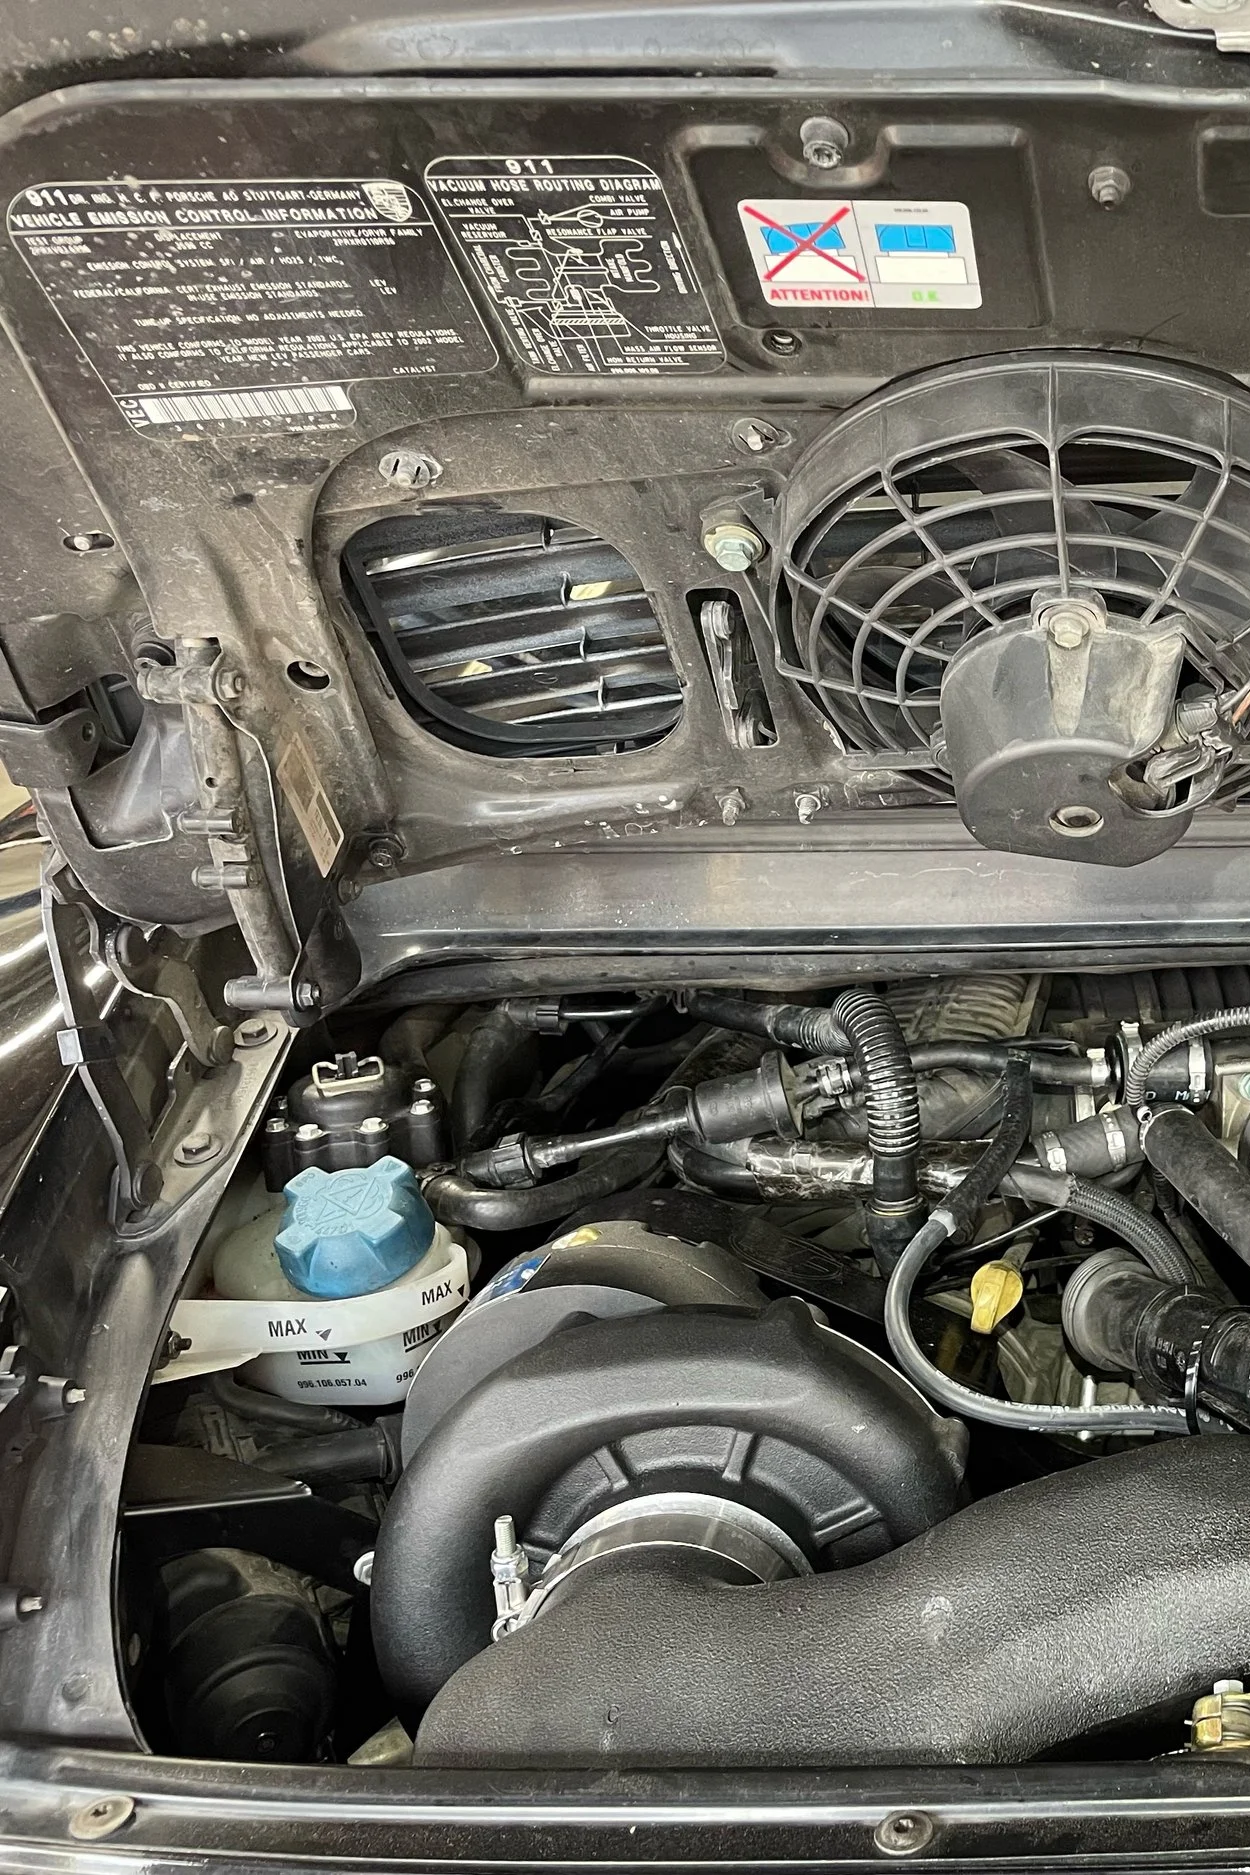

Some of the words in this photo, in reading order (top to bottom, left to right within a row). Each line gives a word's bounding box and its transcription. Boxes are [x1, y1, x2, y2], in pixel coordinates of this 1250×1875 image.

[505, 159, 554, 174] 911
[427, 179, 486, 192] VACUUM
[489, 179, 530, 192] HOSE
[533, 179, 596, 192] ROUTING
[598, 178, 662, 190] DIAGRAM
[25, 189, 69, 207] 911
[166, 190, 217, 203] PORSCHE
[222, 188, 240, 202] AG
[490, 198, 515, 206] OVER
[588, 194, 616, 203] COMBI
[618, 194, 647, 203] VALVE
[468, 206, 497, 215] VALVE
[609, 208, 624, 216] AIR
[626, 208, 650, 216] PUMP
[10, 212, 84, 228] VEHICLE
[87, 210, 172, 226] EMISSION
[175, 208, 254, 224] CONTROL
[262, 207, 379, 221] INFORMATION
[462, 223, 498, 231] VACUUM
[546, 228, 594, 236] RESONANCE
[597, 228, 618, 236] FLAP
[619, 228, 648, 236] VALVE
[154, 232, 223, 243] DISPLACEMENT
[390, 228, 424, 238] FAMILY
[460, 231, 508, 239] RESERVOIR
[200, 241, 214, 250] CC
[86, 261, 130, 272] EMISSION
[249, 257, 266, 266] AIR
[205, 284, 247, 294] EXHAUST
[251, 282, 292, 292] EMISSION
[369, 279, 387, 288] LEV
[221, 292, 263, 301] EMISSION
[379, 286, 398, 296] LEV
[769, 288, 870, 302] ATTENTION!
[263, 310, 326, 321] ADJUSTMENTS
[644, 325, 683, 333] THROTTLE
[686, 324, 712, 332] VALVE
[138, 342, 176, 352] VEHICLE
[178, 339, 227, 351] CONFORMS
[278, 336, 302, 344] YEAR
[306, 334, 326, 344] 2002
[349, 332, 369, 340] EPA
[372, 330, 394, 340] NLEV
[663, 332, 698, 340] HOUSING
[118, 354, 128, 362] IT
[132, 352, 156, 361] ALSO
[157, 348, 206, 359] CONFORMS
[208, 348, 222, 356] TO
[224, 345, 276, 356] CALIFORNIA
[278, 342, 338, 352] REGULATIONS
[342, 339, 393, 350] APPLICABLE
[396, 338, 410, 346] TO
[413, 336, 432, 346] 2002
[435, 335, 464, 345] MODEL
[624, 344, 646, 353] MASS
[648, 344, 660, 352] AIR
[664, 344, 685, 352] FLOW
[688, 344, 718, 352] SENSOR
[220, 355, 245, 364] YEAR
[248, 354, 268, 363] NEW
[272, 352, 288, 361] LEV
[292, 350, 344, 360] PASSENGER
[626, 356, 657, 364] RETURN
[659, 356, 684, 364] VALVE
[392, 365, 436, 376] CATALYST
[168, 379, 213, 390] CERTIFIED
[119, 399, 151, 429] VEC
[421, 1280, 453, 1306] MAX
[268, 1318, 308, 1338] MAX
[402, 1322, 430, 1348] MIN
[297, 1350, 329, 1361] MIN
[297, 1378, 368, 1390] 996.106.057.04
